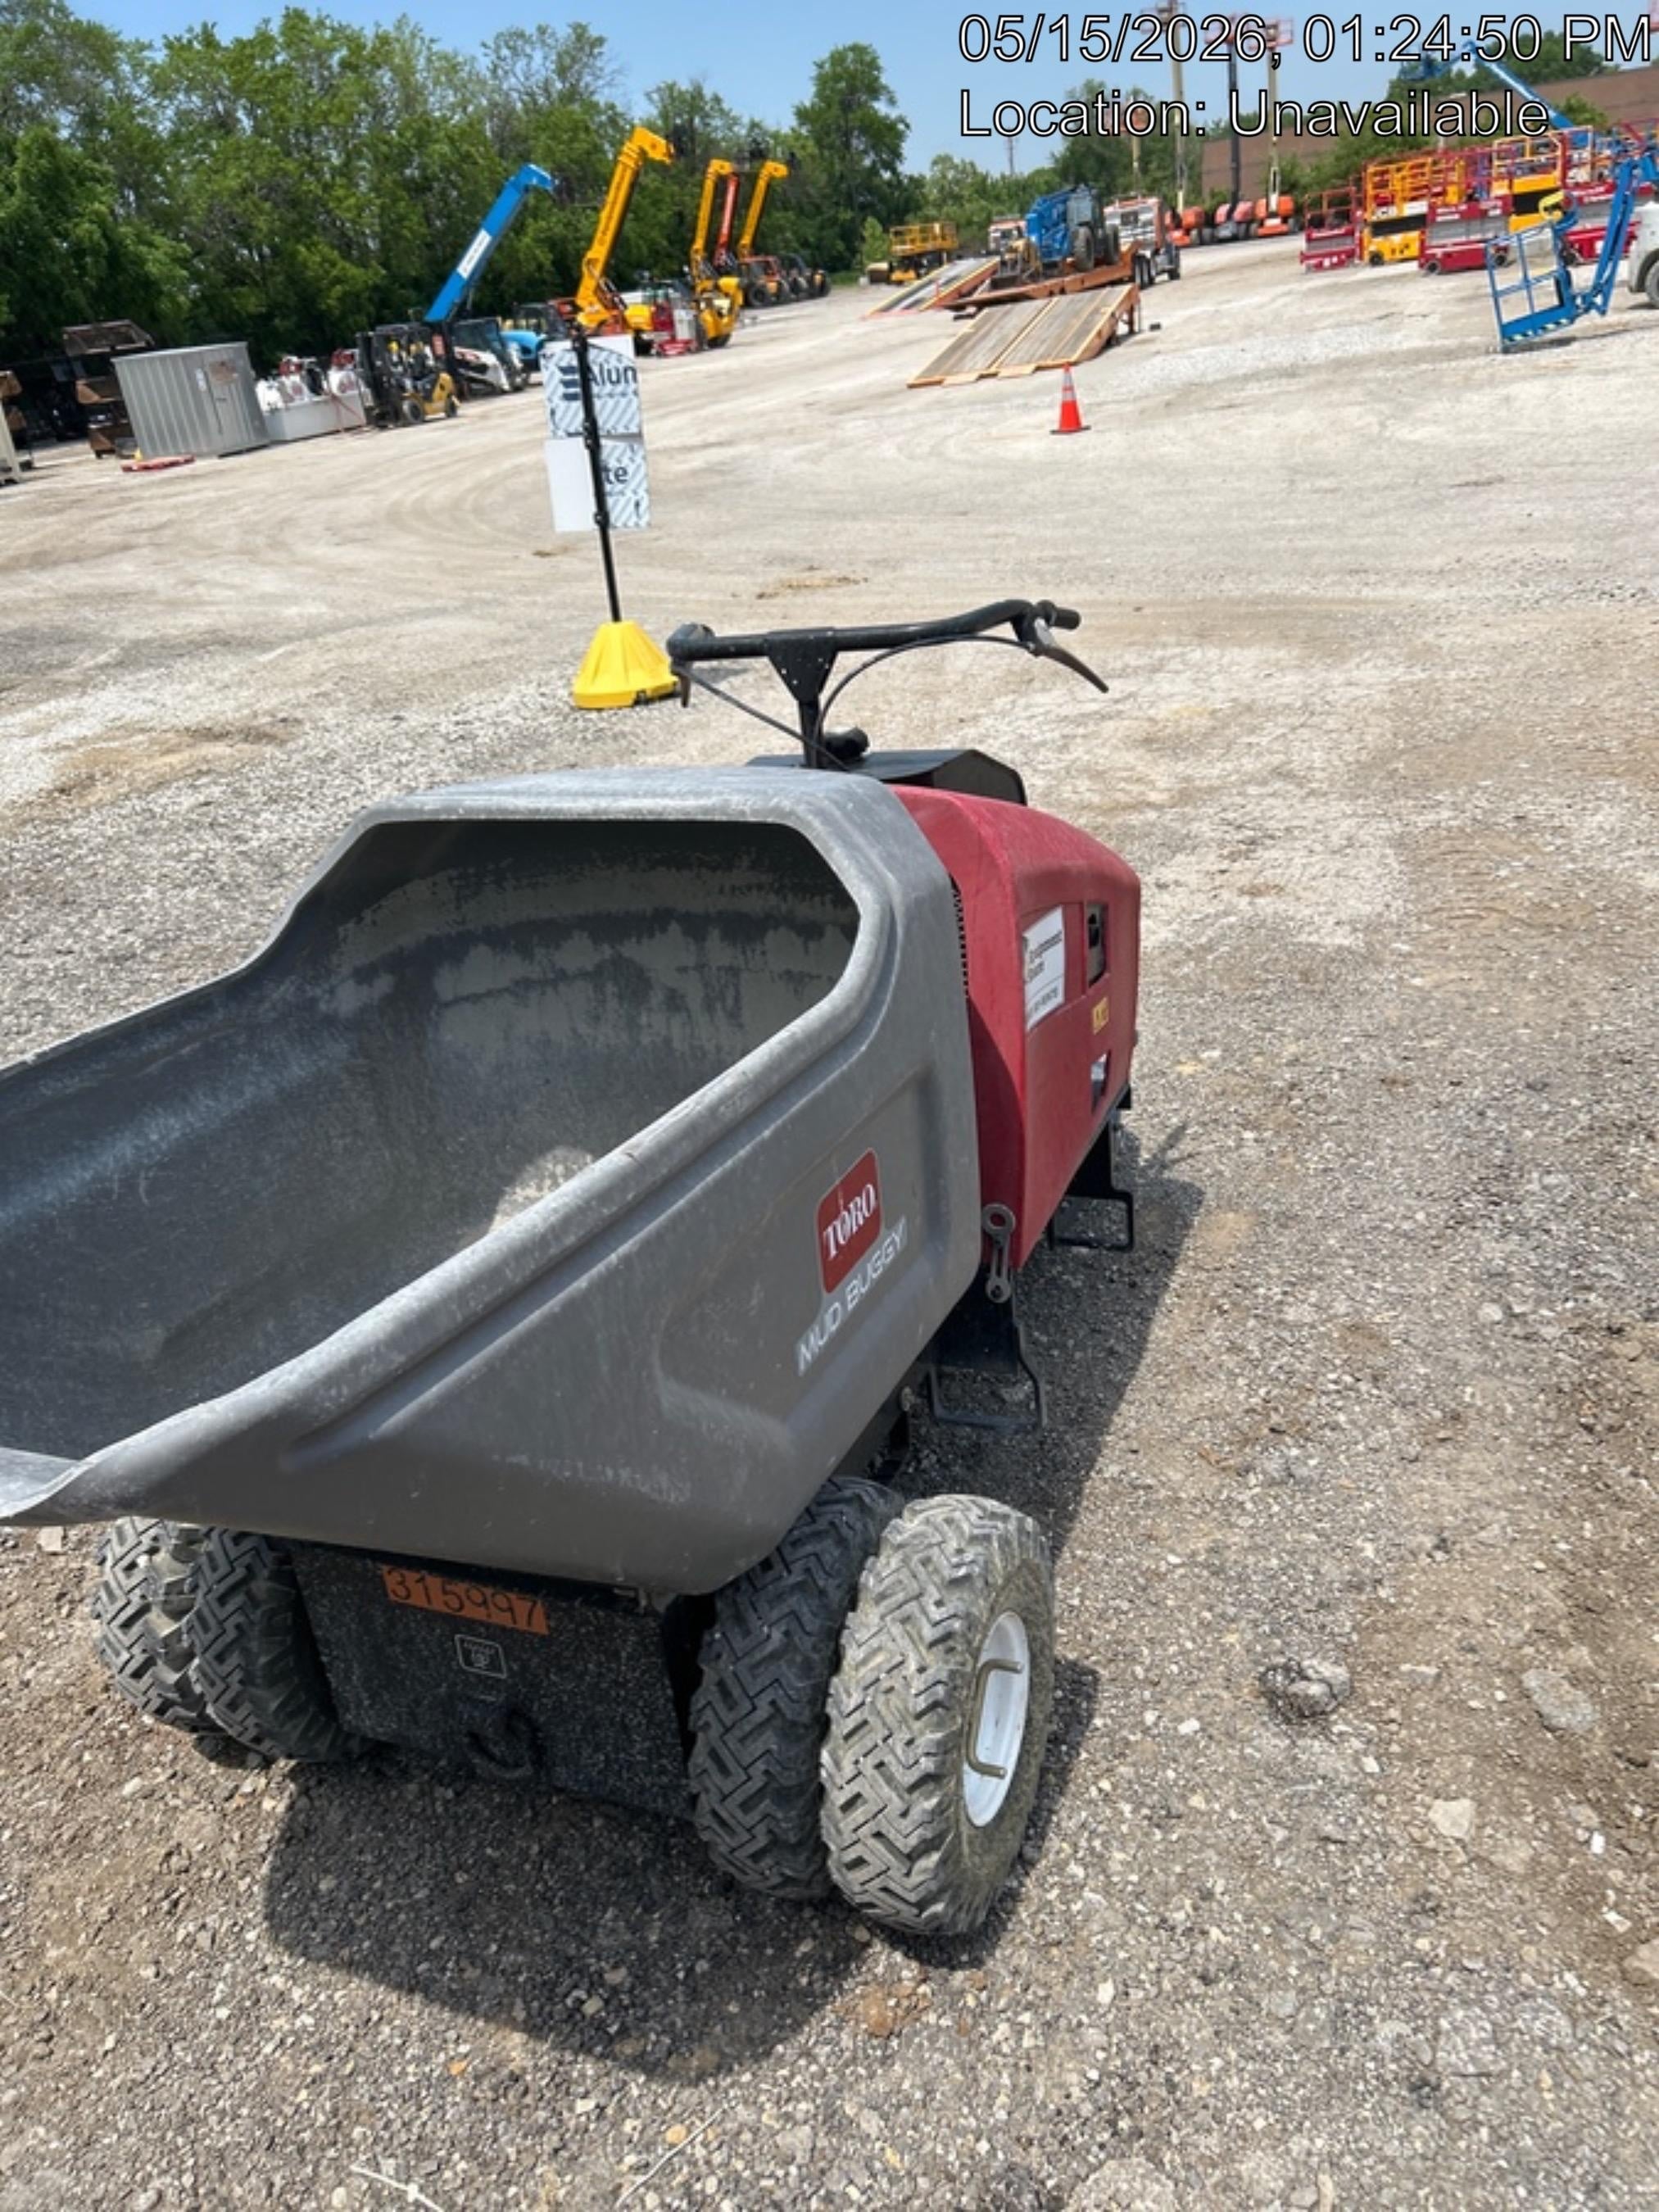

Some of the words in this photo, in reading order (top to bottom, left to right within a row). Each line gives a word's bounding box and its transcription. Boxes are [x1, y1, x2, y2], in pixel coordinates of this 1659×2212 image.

[823, 1183, 877, 1261] TORO
[796, 1301, 842, 1377] MUD
[845, 1213, 908, 1312] BUGGY
[387, 1567, 537, 1629] 315997
